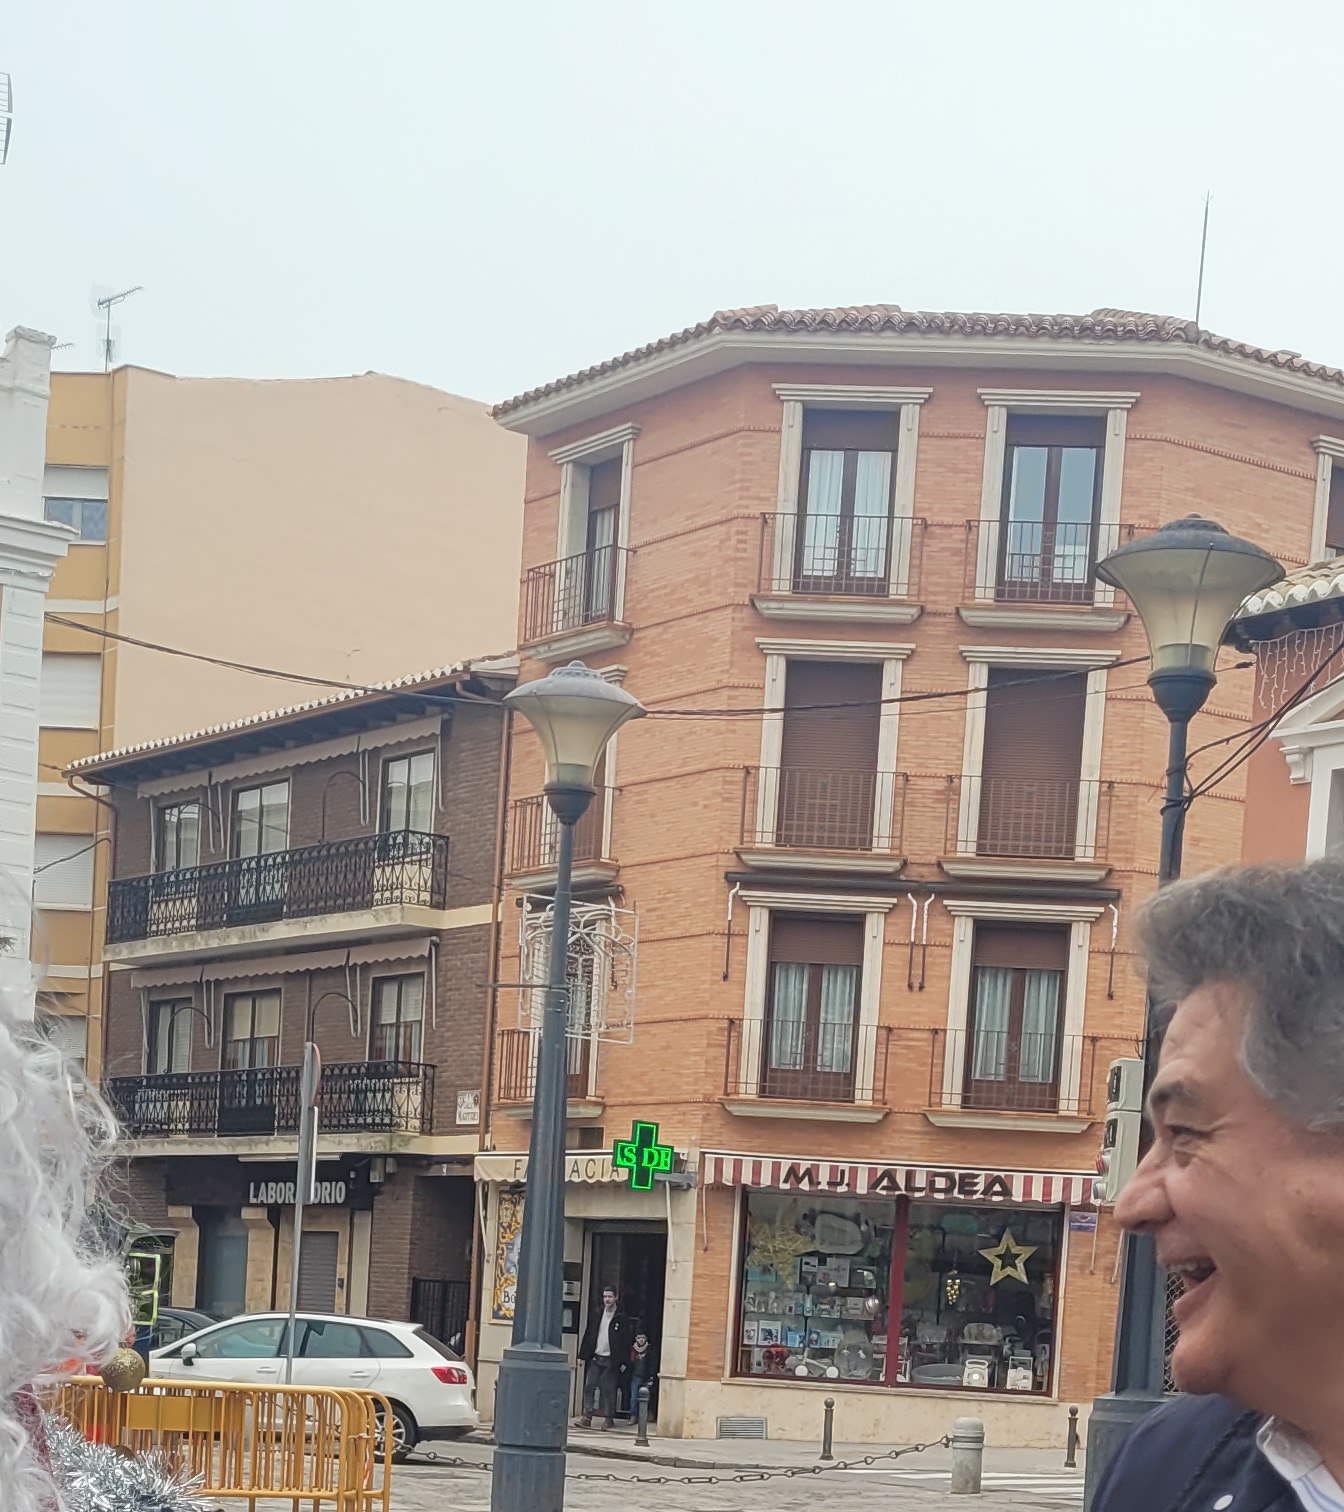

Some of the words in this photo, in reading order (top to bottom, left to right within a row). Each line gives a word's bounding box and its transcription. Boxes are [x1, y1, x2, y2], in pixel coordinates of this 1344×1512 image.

[514, 1158, 620, 1180] FACIA
[249, 1181, 346, 1204] LABORORIO
[868, 1167, 1013, 1198] ALDEA
